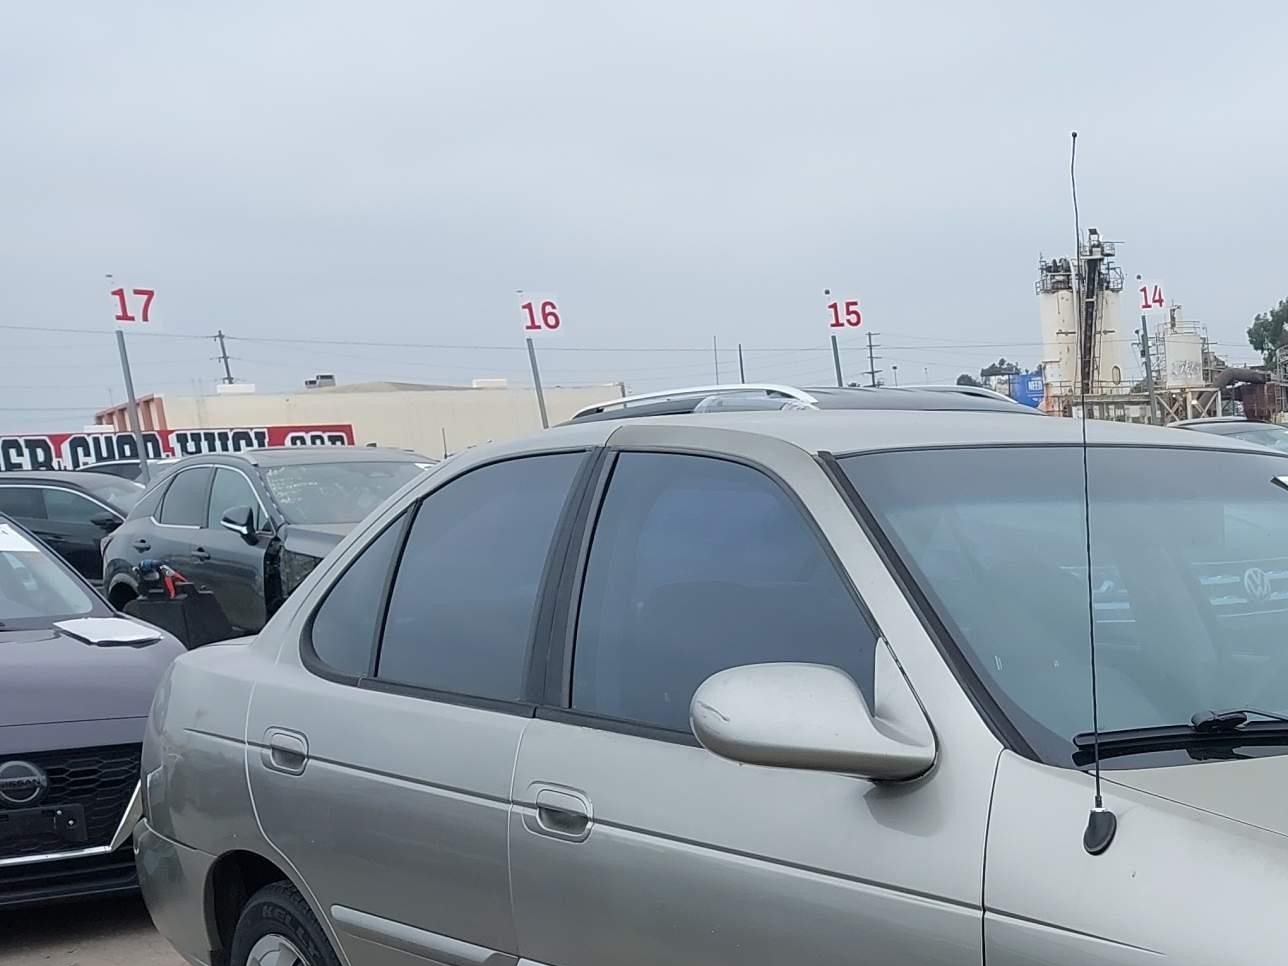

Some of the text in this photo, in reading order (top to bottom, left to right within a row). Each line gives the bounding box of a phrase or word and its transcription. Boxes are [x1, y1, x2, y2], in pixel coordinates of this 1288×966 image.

[111, 288, 154, 322] 17
[1140, 285, 1164, 308] 14
[521, 301, 560, 329] 16
[828, 301, 861, 327] 15
